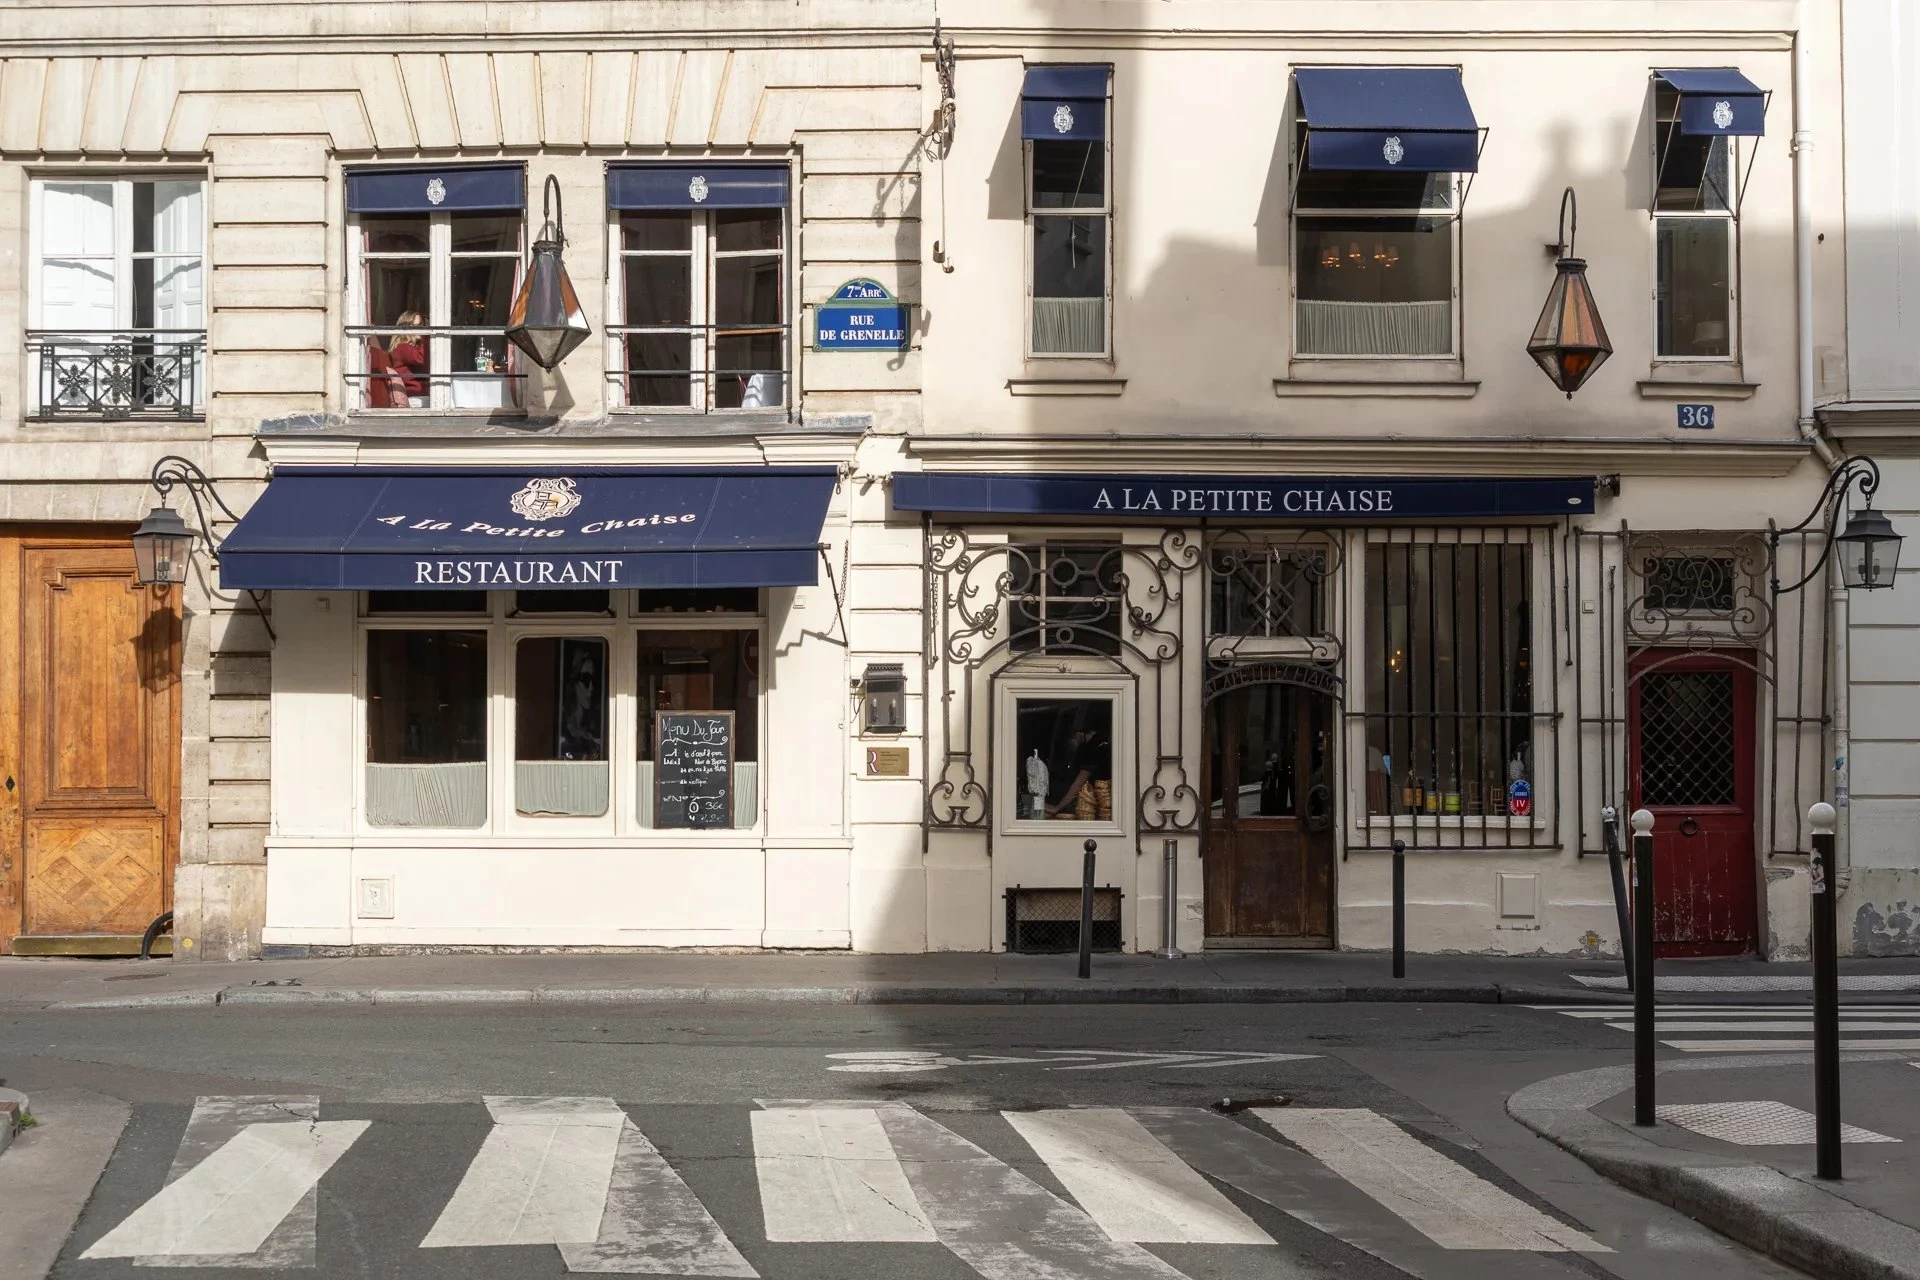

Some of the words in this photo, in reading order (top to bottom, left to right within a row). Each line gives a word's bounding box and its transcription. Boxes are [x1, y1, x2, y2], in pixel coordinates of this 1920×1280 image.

[850, 315, 875, 326] RUE
[820, 330, 836, 341] DE
[840, 329, 905, 341] GRENELLE
[1683, 406, 1709, 427] 36
[1093, 487, 1114, 509] A
[1122, 487, 1162, 510] LA
[1170, 489, 1273, 512] PETITE
[1283, 489, 1394, 512] CHAISE
[376, 515, 406, 526] A
[409, 519, 453, 530] La
[460, 521, 565, 538] Petite
[581, 513, 696, 534] Chaise
[415, 560, 623, 585] RESTAURANT
[662, 717, 690, 740] Menu
[692, 719, 705, 736] Du
[1516, 800, 1526, 808] IV
